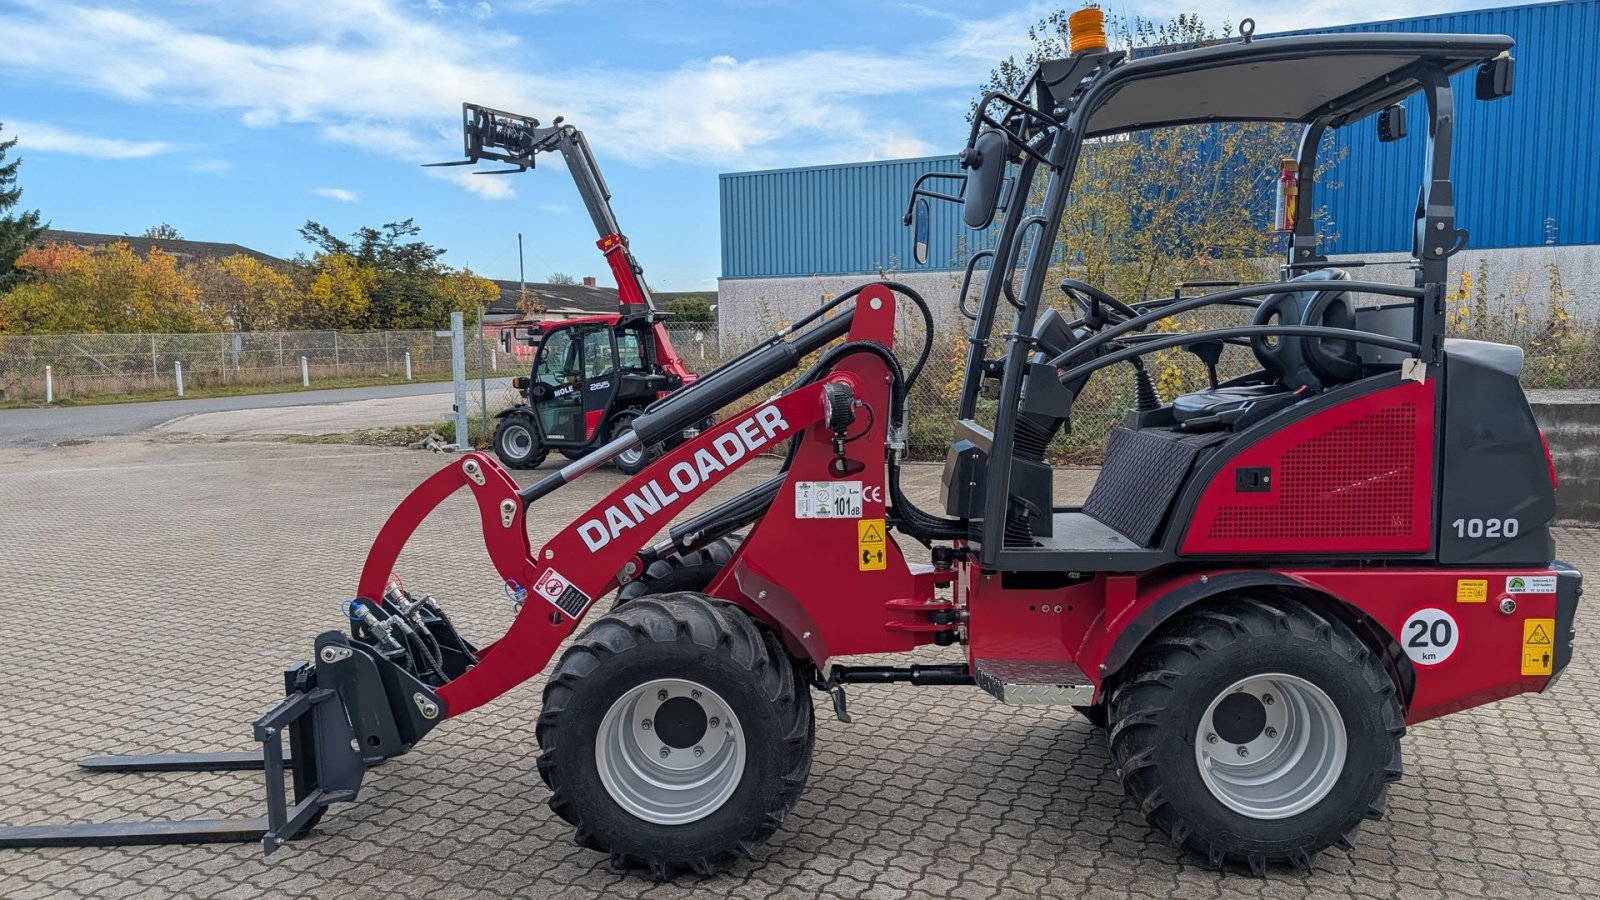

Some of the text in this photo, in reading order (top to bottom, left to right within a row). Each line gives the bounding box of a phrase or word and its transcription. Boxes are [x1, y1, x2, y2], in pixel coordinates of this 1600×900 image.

[554, 385, 574, 398] MOLE
[576, 404, 790, 553] DANLOADER
[1452, 518, 1519, 538] 1020
[1408, 618, 1452, 648] 20
[1422, 652, 1436, 660] km
